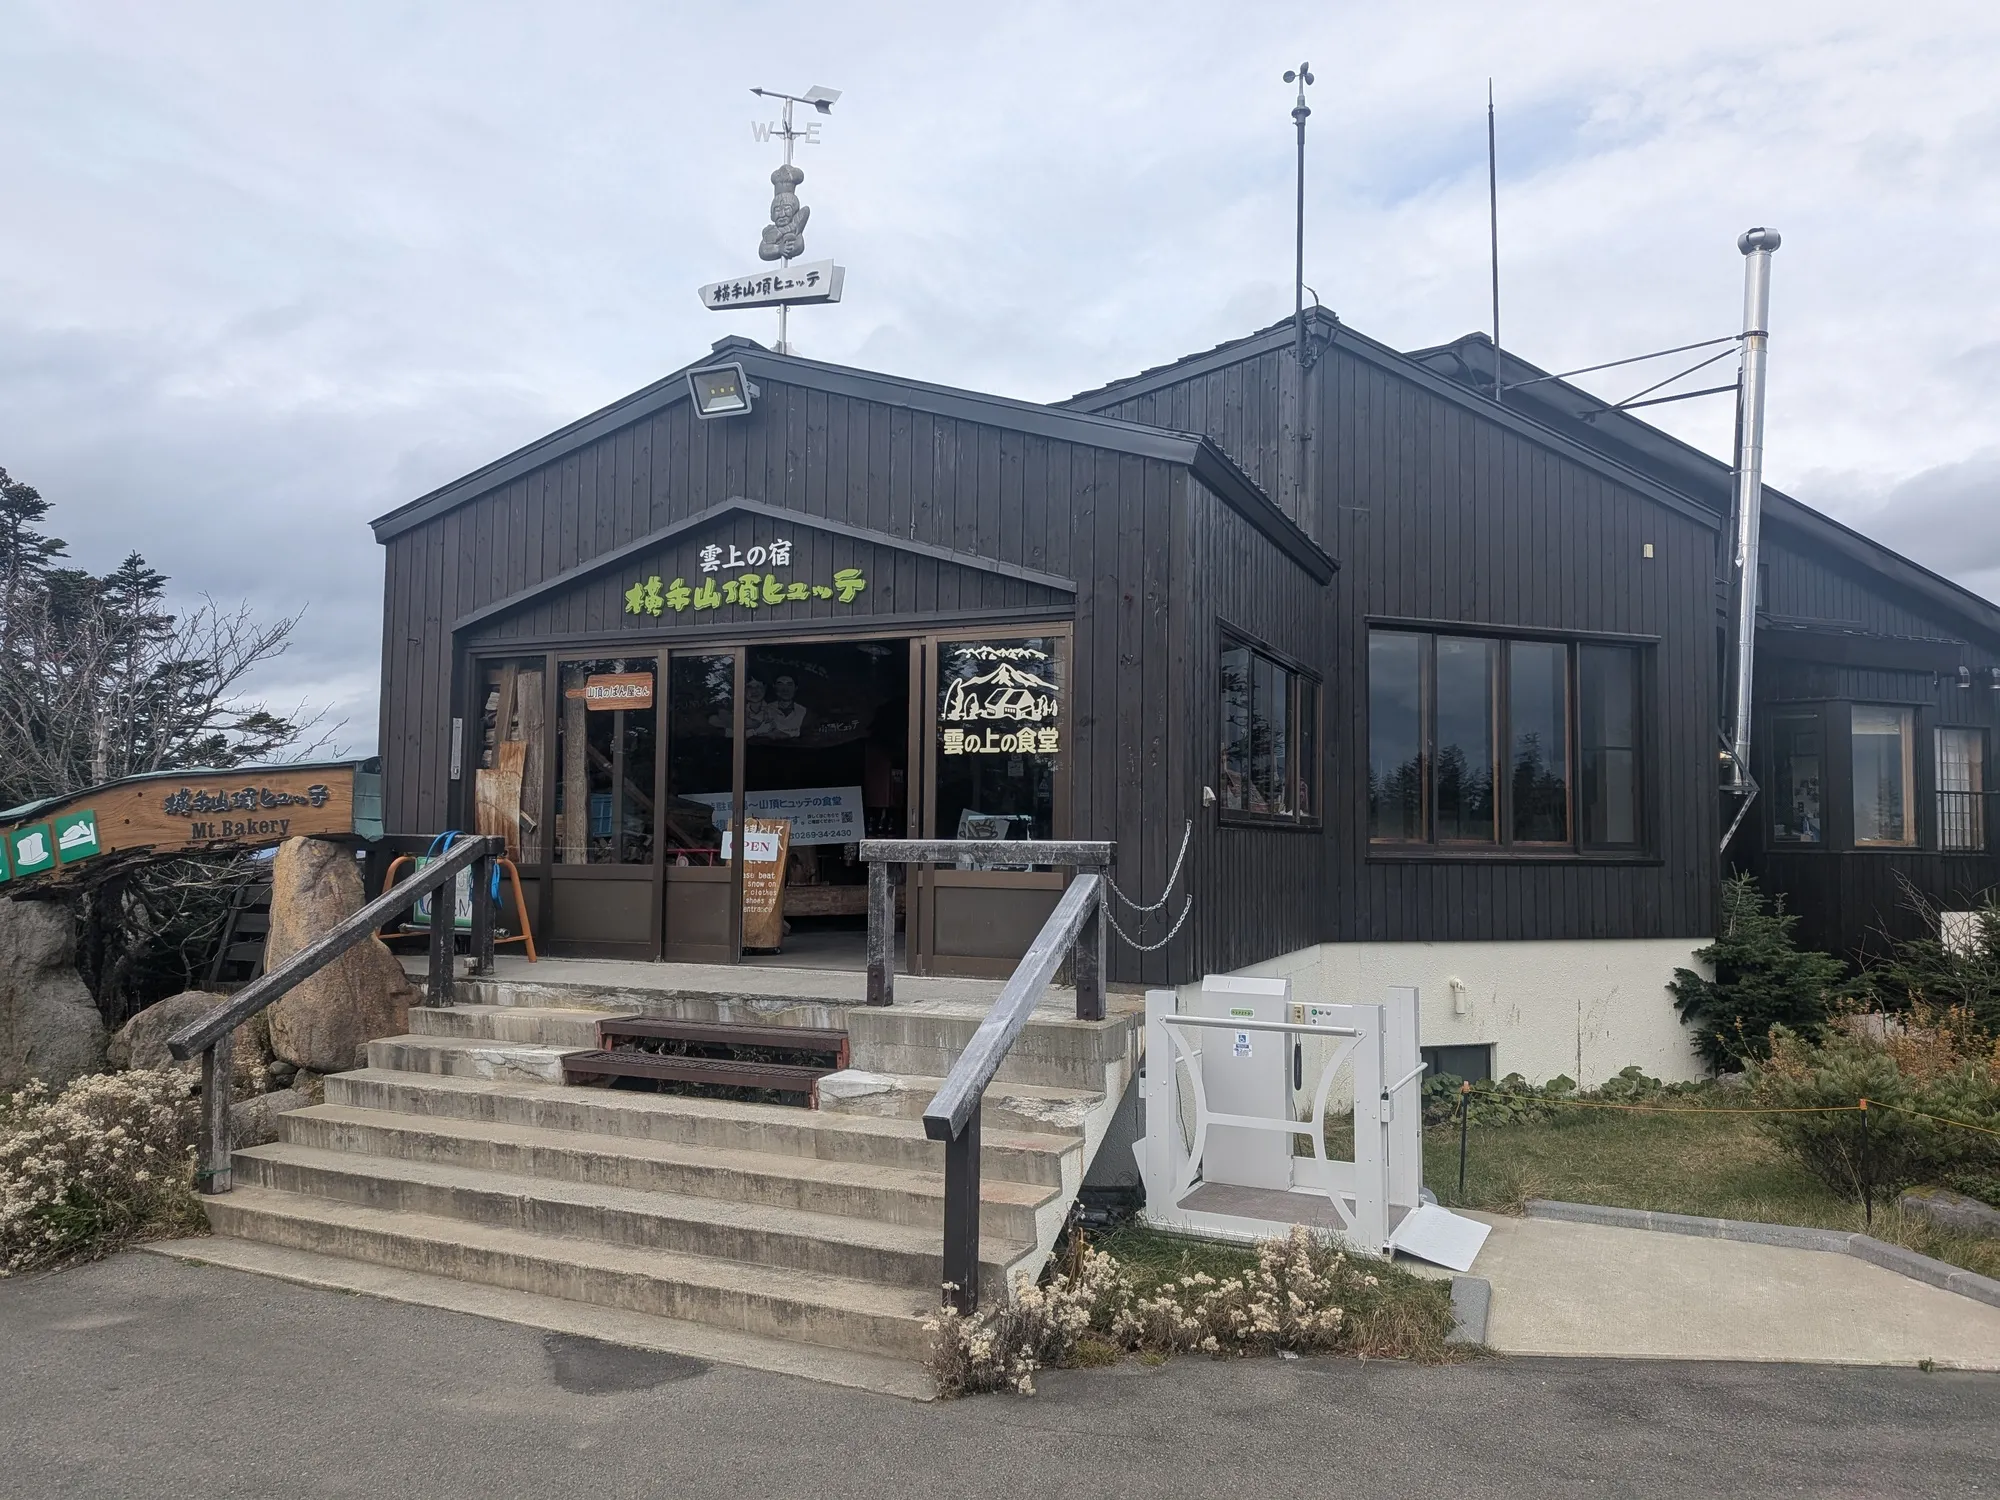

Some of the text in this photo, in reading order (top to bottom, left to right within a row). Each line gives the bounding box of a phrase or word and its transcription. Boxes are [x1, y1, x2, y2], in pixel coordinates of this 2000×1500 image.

[751, 120, 823, 144] W E
[714, 271, 820, 302] 横手山頂ヒュッテ
[699, 539, 793, 572] 雲上の宿
[624, 568, 867, 617] 横手山頂ヒュッテ
[943, 726, 1059, 754] 雲の上の食堂
[164, 784, 329, 816] 横手山頂ヒュッテ
[729, 840, 771, 852] PEN
